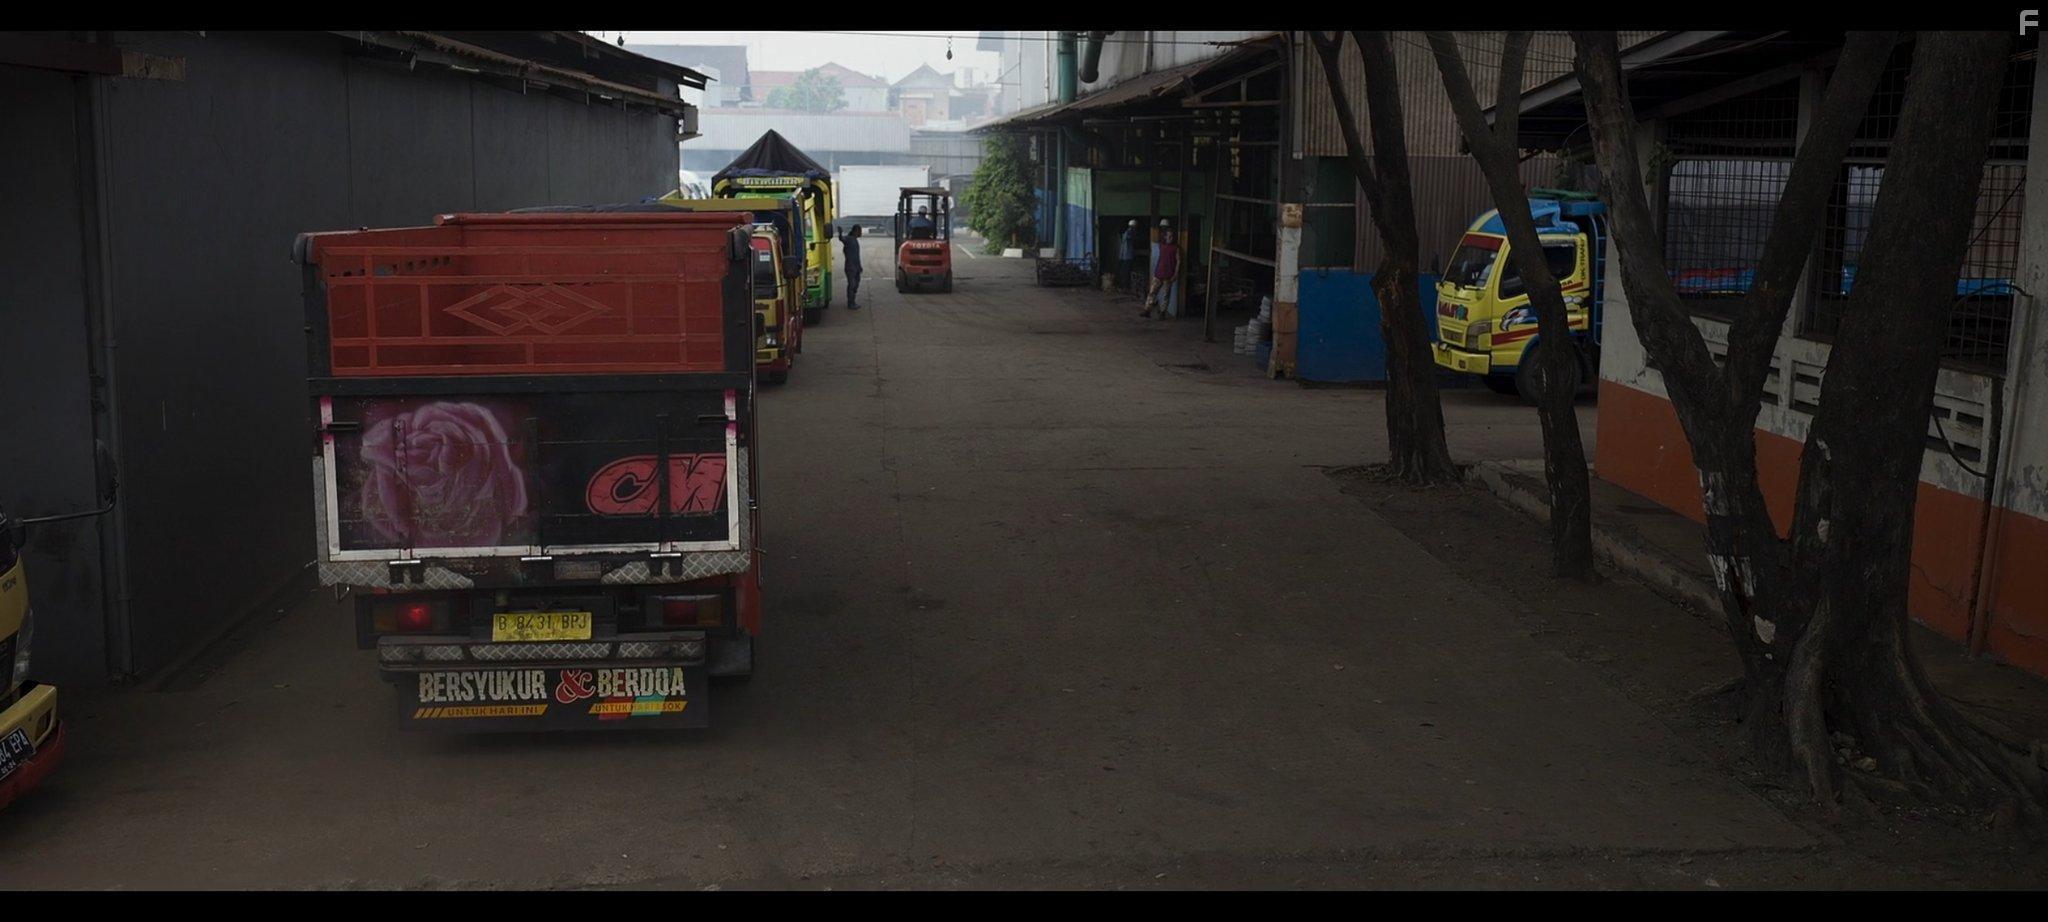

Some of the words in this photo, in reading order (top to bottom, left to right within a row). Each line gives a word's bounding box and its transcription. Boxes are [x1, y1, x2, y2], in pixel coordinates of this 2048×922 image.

[498, 615, 507, 631] B
[516, 614, 552, 631] 8431
[561, 614, 587, 630] BPJ
[418, 669, 548, 703] BERSYUKUR
[555, 669, 597, 704] &
[597, 667, 686, 698] BERDOA
[448, 707, 486, 717] UNTUK
[490, 706, 515, 715] HARI
[521, 706, 539, 714] INI
[595, 703, 628, 712] UNTUK
